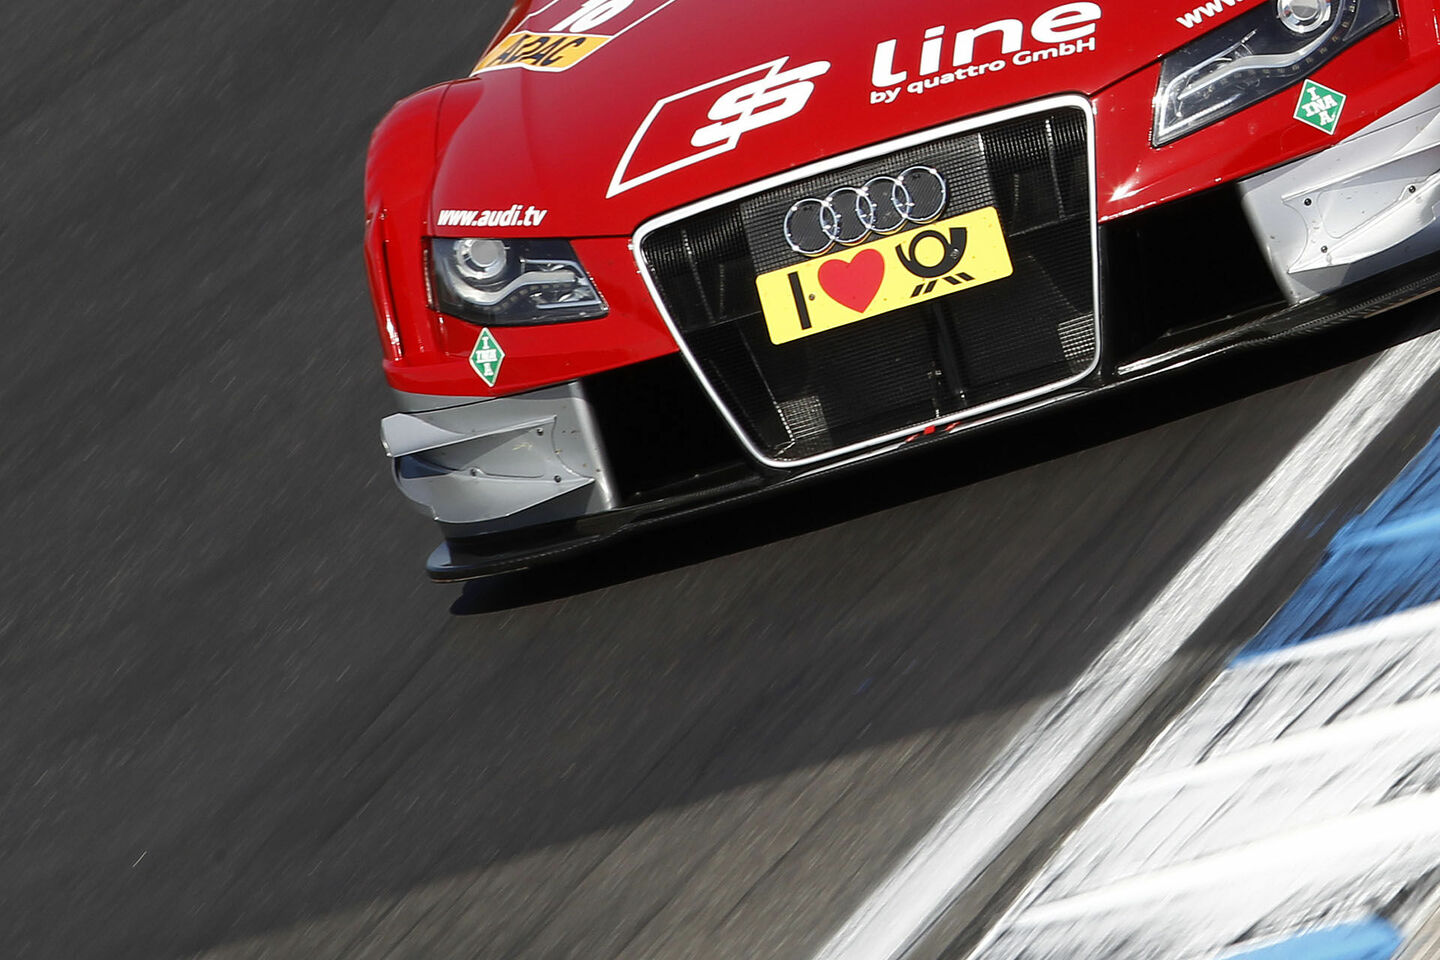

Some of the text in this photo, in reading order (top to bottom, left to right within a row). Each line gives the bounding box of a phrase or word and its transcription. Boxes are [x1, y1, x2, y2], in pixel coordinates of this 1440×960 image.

[870, 37, 1096, 105] by quattro GmbH
[871, 1, 1101, 88] line
[437, 204, 548, 227] www.audi.tv
[788, 271, 813, 330] I
